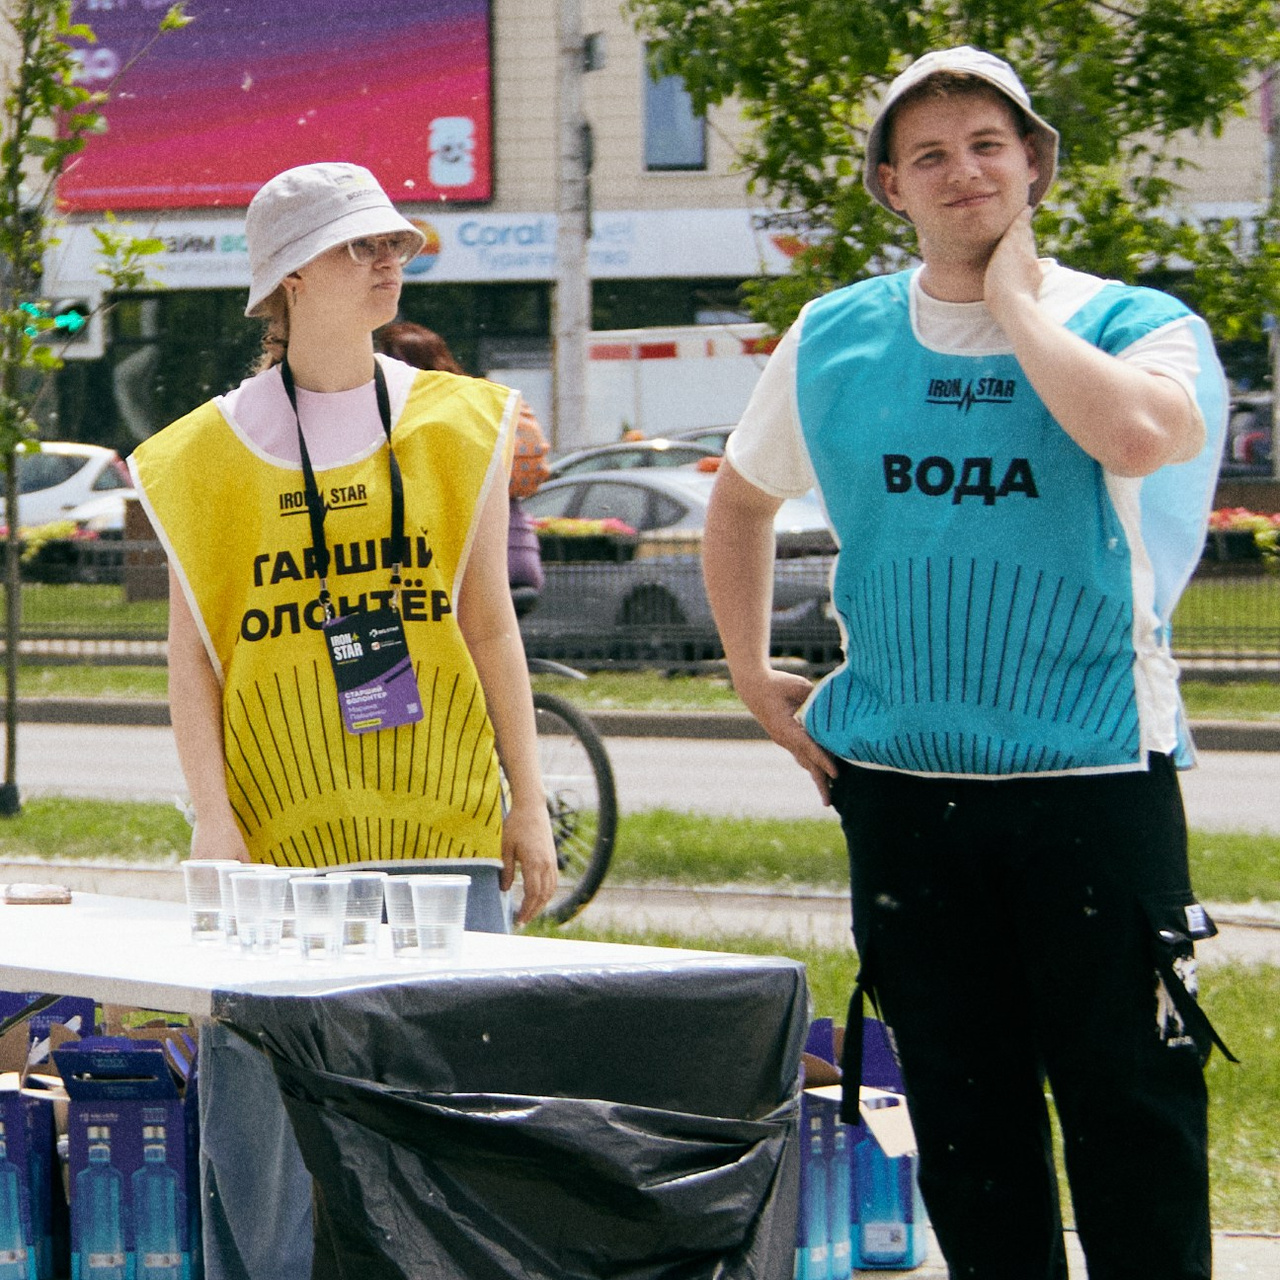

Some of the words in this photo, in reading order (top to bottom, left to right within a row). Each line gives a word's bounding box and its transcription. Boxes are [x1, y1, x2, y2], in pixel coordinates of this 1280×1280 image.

[928, 378, 962, 398] IRON
[976, 377, 1016, 398] STAR
[883, 454, 1040, 506] ВОДА
[330, 484, 368, 504] STAR
[330, 633, 353, 647] IRON
[333, 642, 364, 661] STAR
